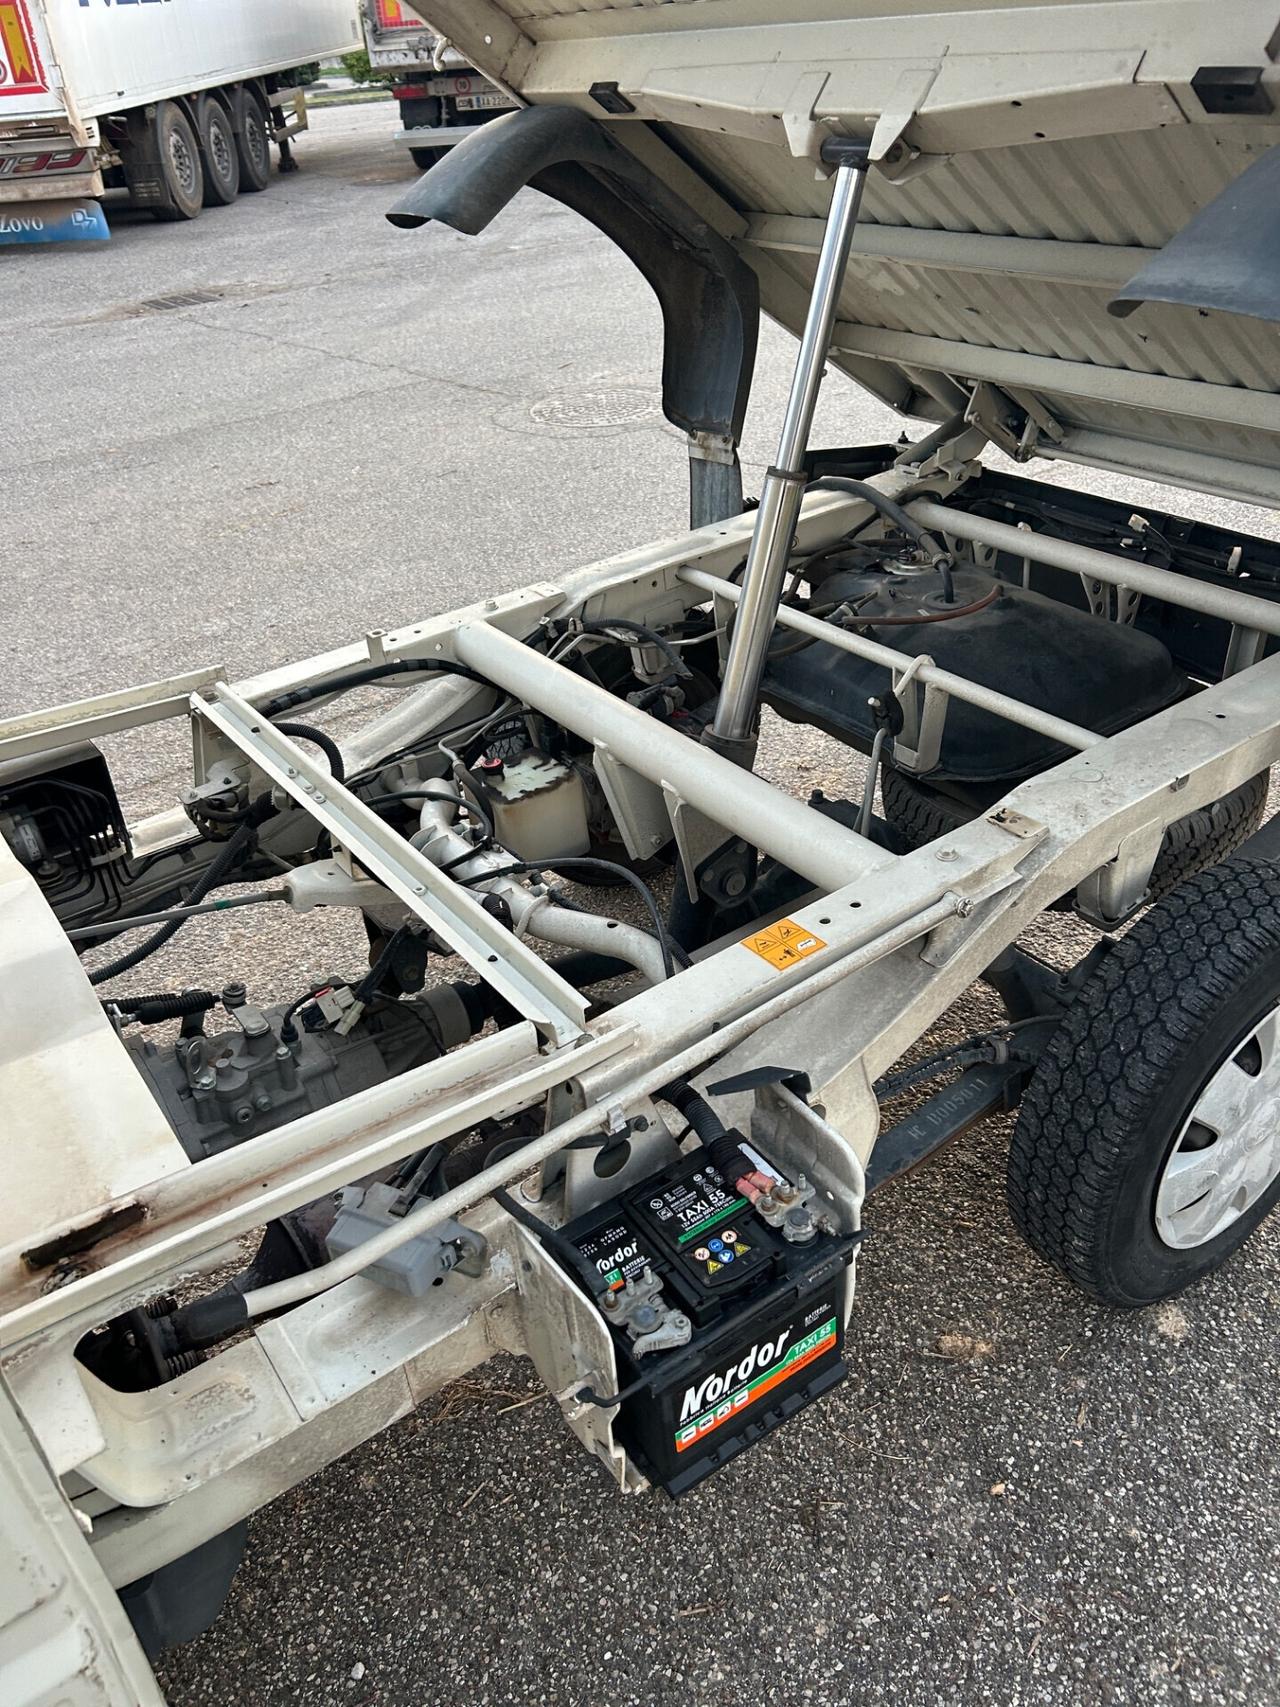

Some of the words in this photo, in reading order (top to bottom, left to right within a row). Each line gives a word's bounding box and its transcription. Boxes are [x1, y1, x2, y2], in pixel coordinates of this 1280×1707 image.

[677, 1200, 710, 1222] TAXI
[708, 1189, 726, 1204] 55
[622, 1255, 646, 1273] BATTERIE
[795, 1333, 817, 1354] TAXI
[819, 1324, 832, 1338] 55
[679, 1330, 790, 1422] Nordor
